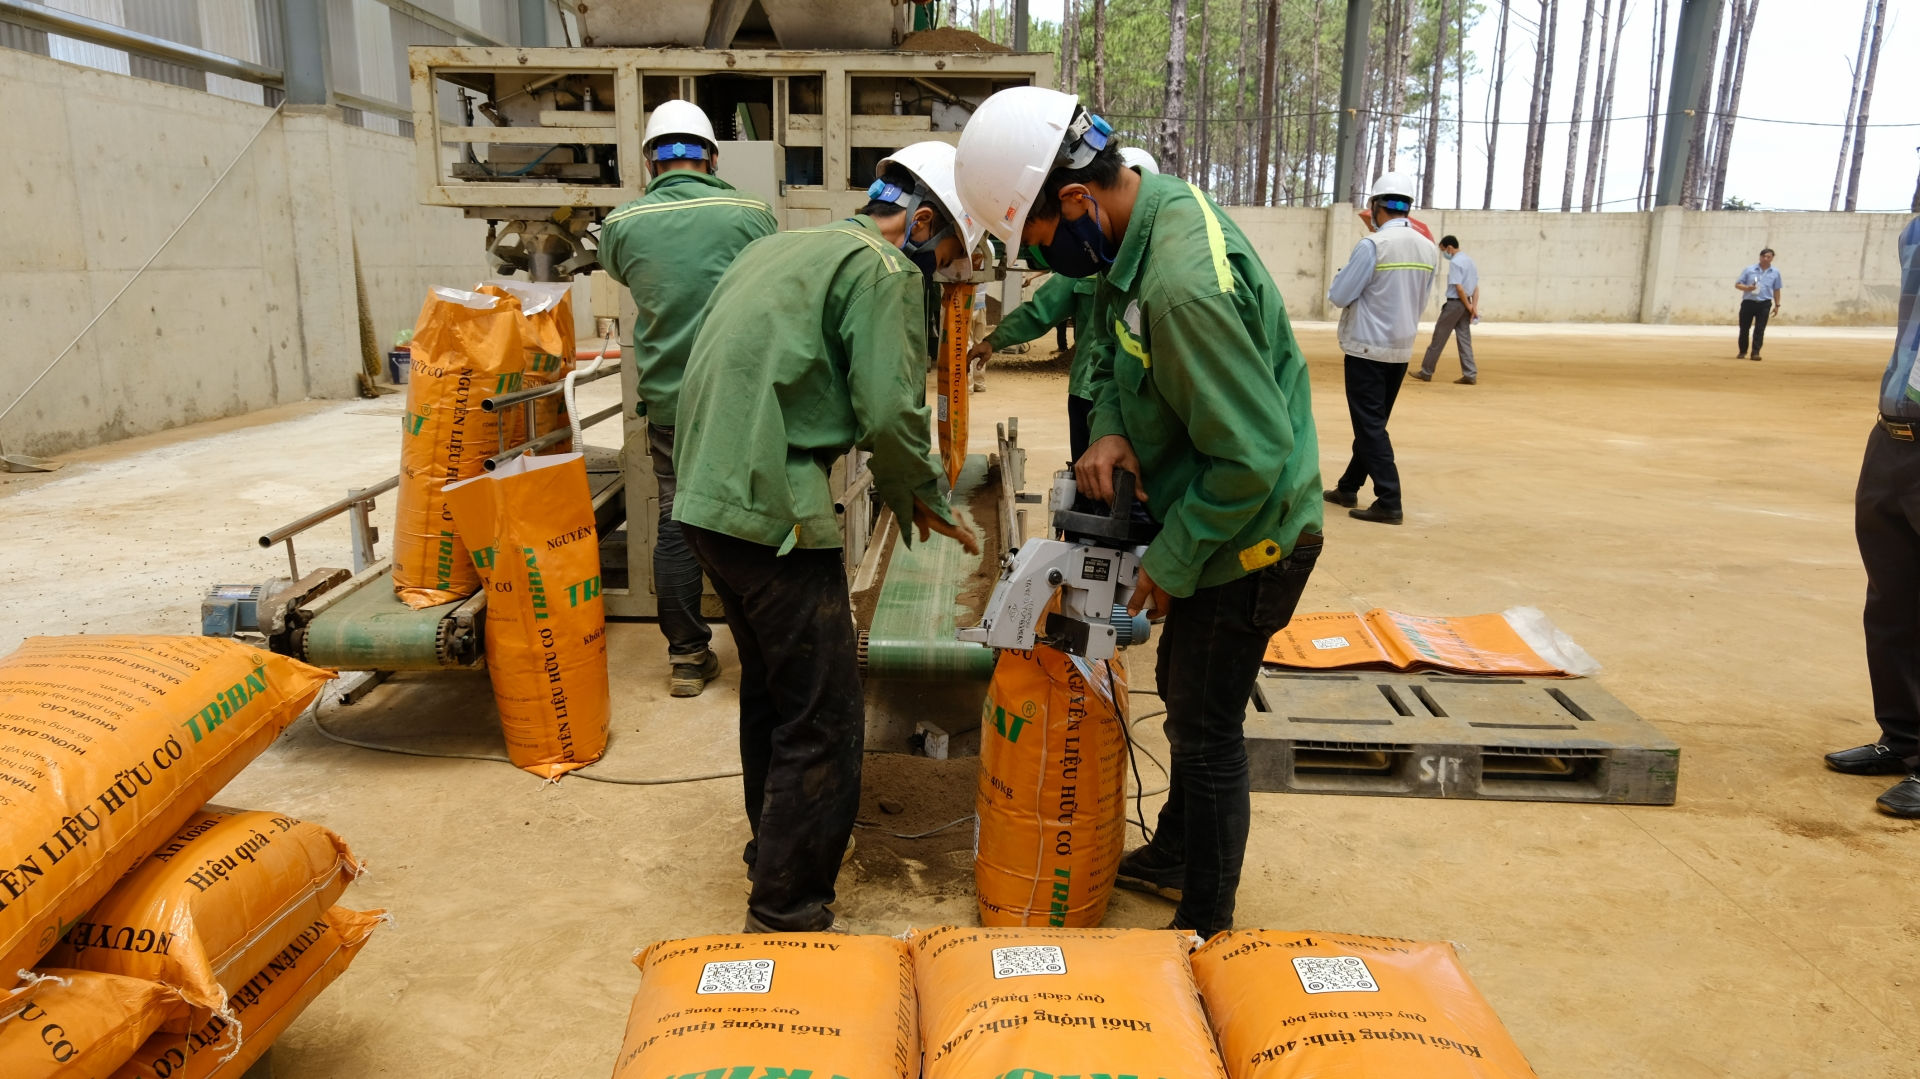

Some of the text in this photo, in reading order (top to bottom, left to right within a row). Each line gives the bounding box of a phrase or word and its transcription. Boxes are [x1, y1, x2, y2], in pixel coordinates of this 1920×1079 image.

[451, 367, 474, 427] NGUYÊN
[445, 429, 466, 465] LIỆU
[546, 525, 593, 551] NGUYÊN
[141, 682, 167, 696] NSX:
[537, 627, 576, 762] UYÊN LIỆU HỮU CƠ
[1055, 660, 1088, 856] NGUYÊN LIỆU HỮU CƠ
[0, 772, 37, 793] THÀN
[990, 775, 1014, 800] 40kg
[0, 854, 44, 912] ÊN
[38, 804, 100, 866] LIỆU
[97, 761, 153, 816] HỮU
[152, 733, 184, 770] CƠ
[154, 842, 186, 863] An
[177, 816, 220, 843] toàn
[184, 853, 239, 893] Hiệu
[234, 829, 271, 864] quả
[268, 918, 330, 977] NGUYÊN
[705, 942, 745, 952] Tiết
[763, 940, 807, 949] toàn
[813, 942, 841, 952] An
[932, 934, 979, 959] kiệm
[228, 970, 274, 1015] LIỆU
[990, 993, 1029, 1006] Dạng
[1033, 991, 1072, 1003] cách:
[1076, 992, 1105, 1005] Quy
[684, 1006, 723, 1015] Dạng
[727, 1006, 767, 1014] cách:
[770, 1006, 800, 1016] Quy
[1033, 1008, 1096, 1029] lượng
[1280, 1009, 1427, 1028] Quy cách: Dạng bột
[721, 1018, 785, 1033] lượng
[791, 1023, 841, 1037] Khối
[978, 1015, 1028, 1035] tịnh:
[1101, 1016, 1153, 1033] Khối
[41, 1023, 80, 1063] CƠ
[1302, 1029, 1357, 1047] tịnh:
[1358, 1027, 1427, 1046] lượng
[1429, 1034, 1484, 1059] Khối
